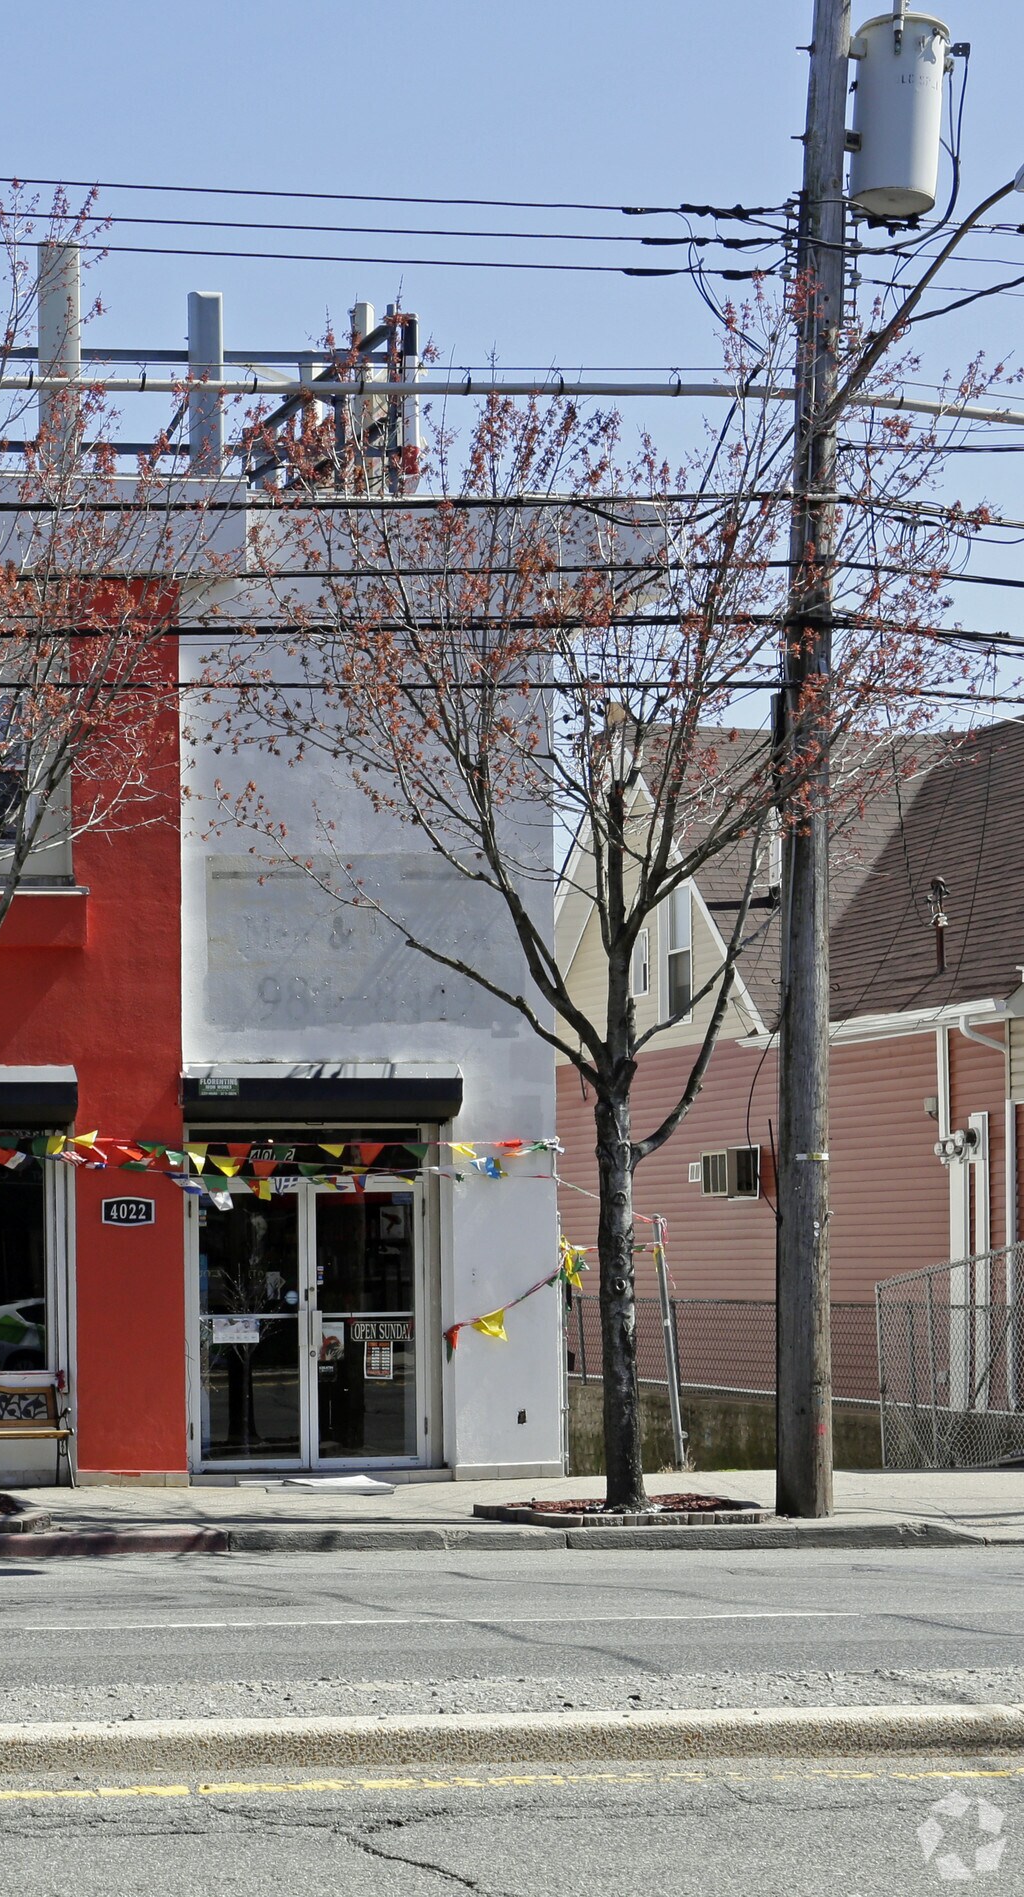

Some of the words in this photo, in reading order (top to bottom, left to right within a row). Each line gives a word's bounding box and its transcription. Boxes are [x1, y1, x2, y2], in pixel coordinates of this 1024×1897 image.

[249, 1149, 295, 1163] 402
[110, 1203, 146, 1219] 4022
[355, 1323, 377, 1339] OPEN
[379, 1323, 412, 1340] SUNDAY
